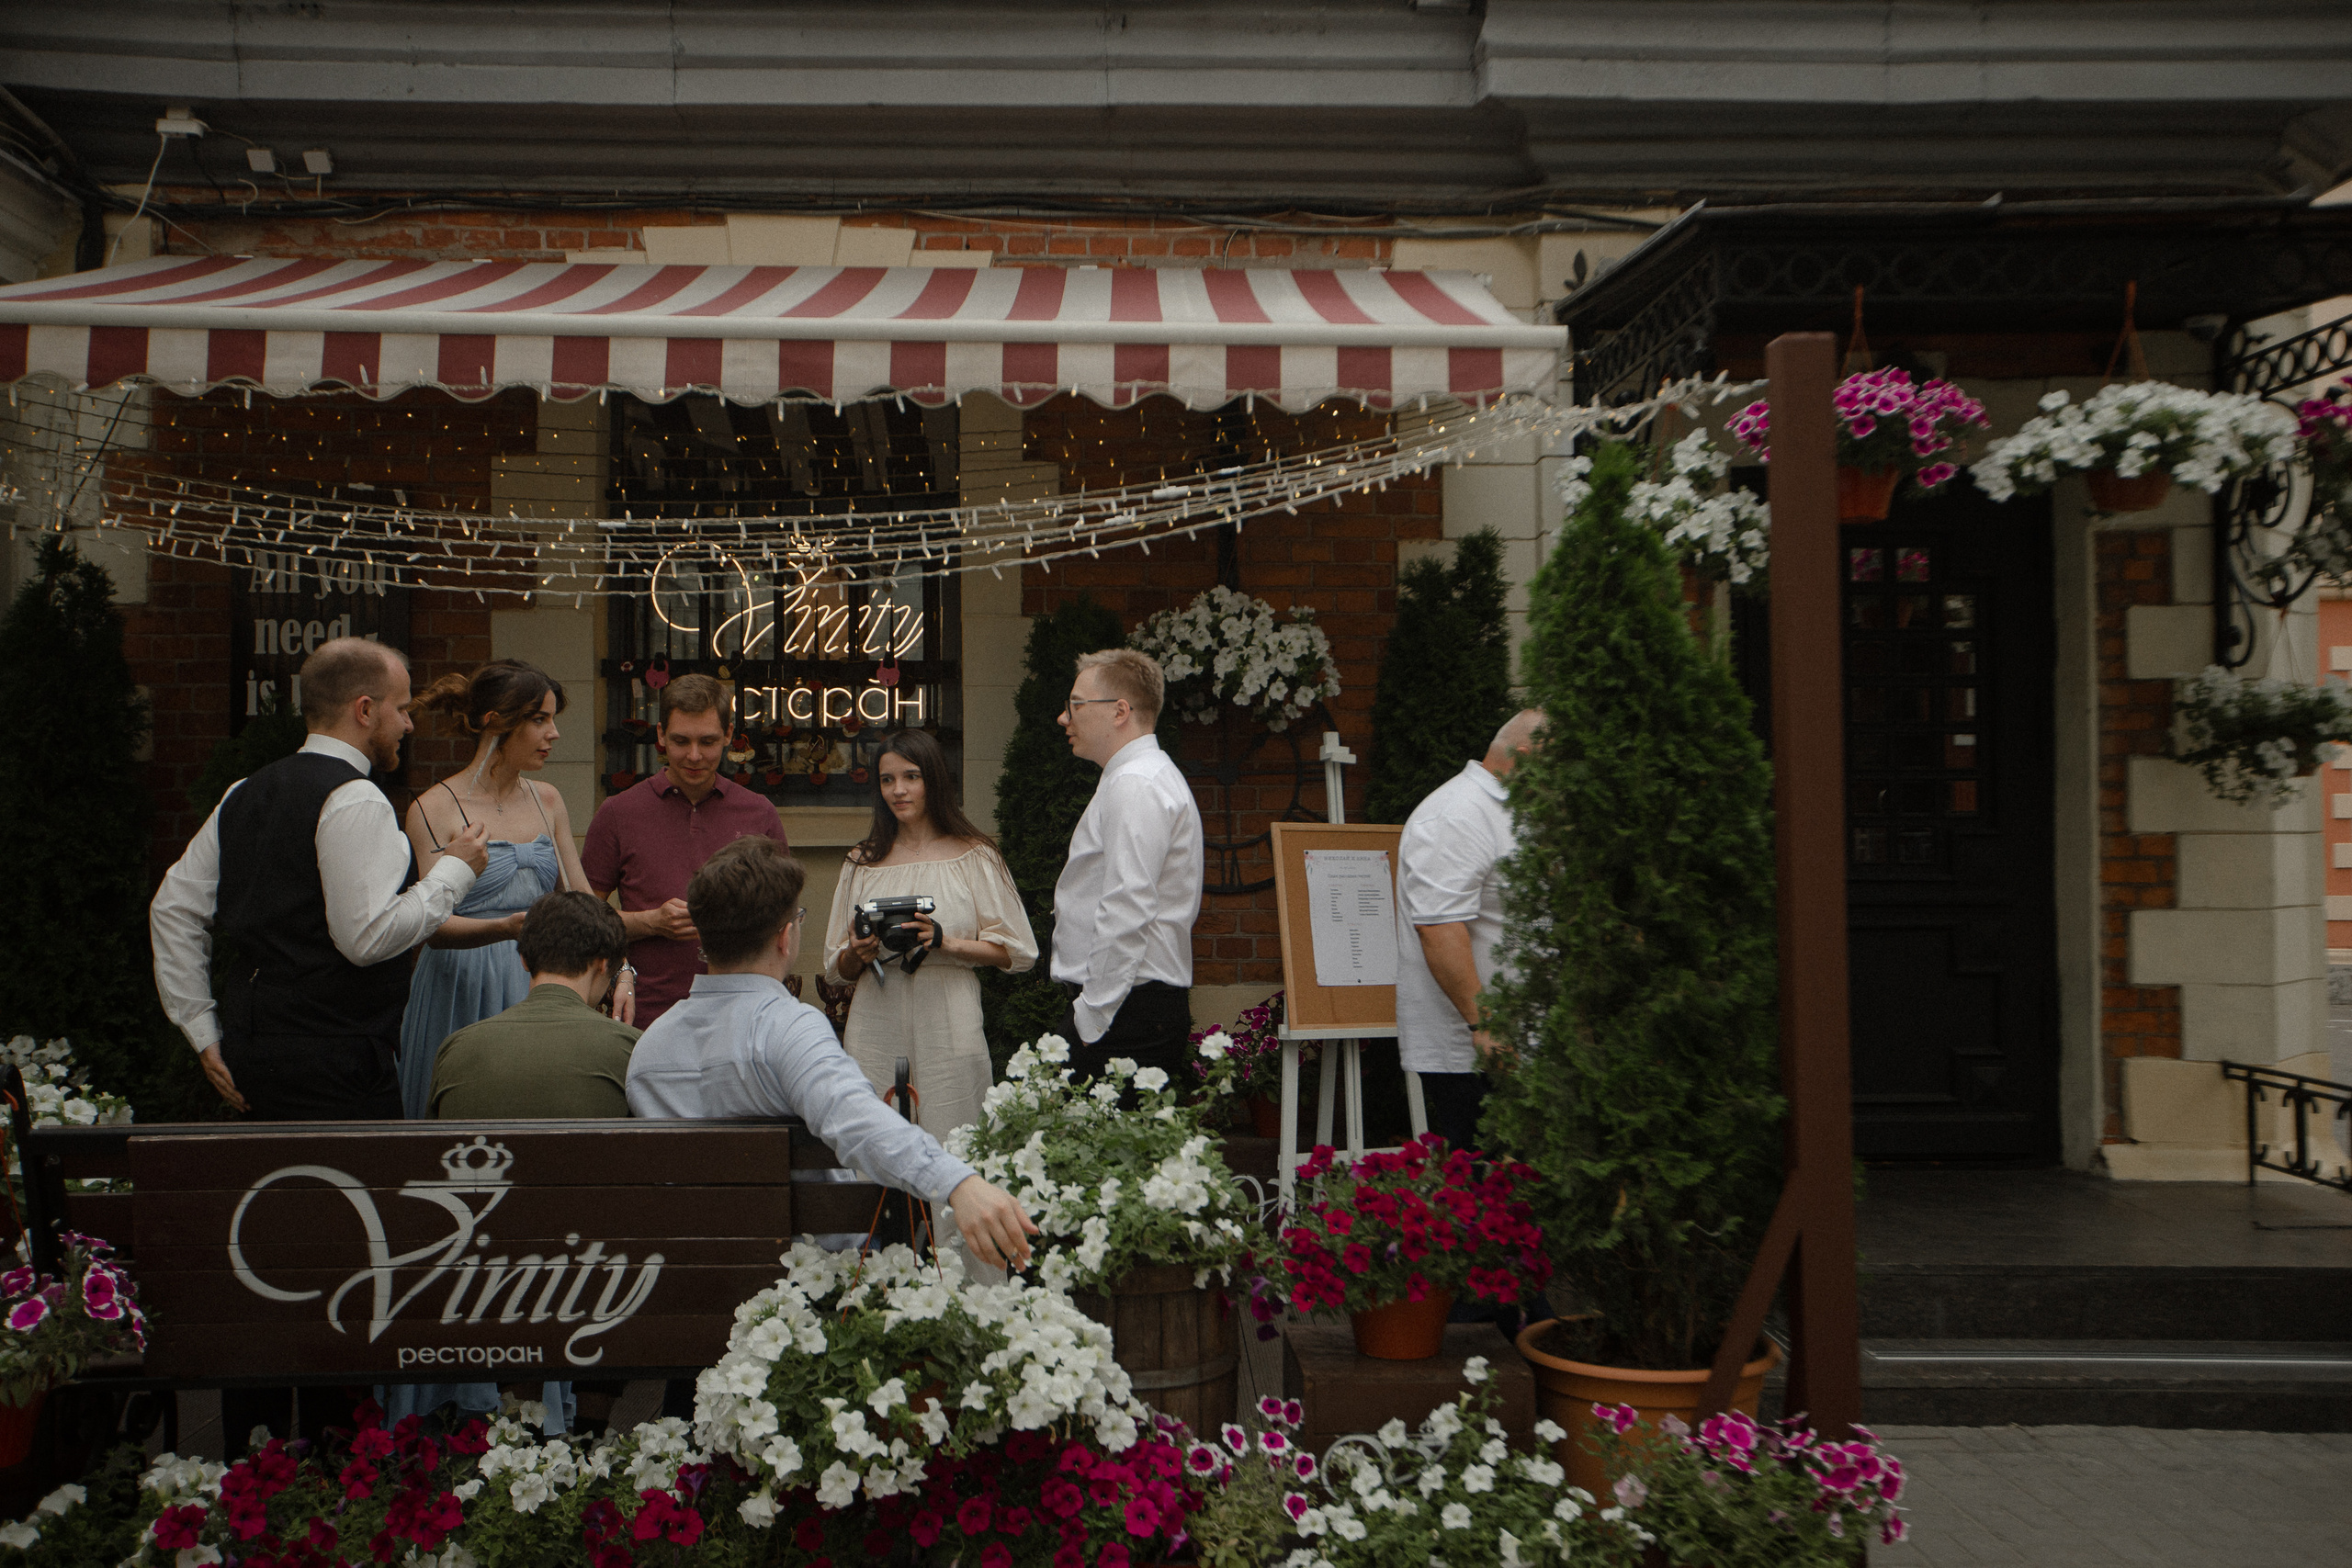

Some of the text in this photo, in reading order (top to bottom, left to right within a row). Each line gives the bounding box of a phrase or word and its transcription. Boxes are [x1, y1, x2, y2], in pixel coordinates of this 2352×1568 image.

[248, 551, 387, 600] All you
[228, 1165, 665, 1366] Vinity
[398, 1346, 543, 1369] ресторан
